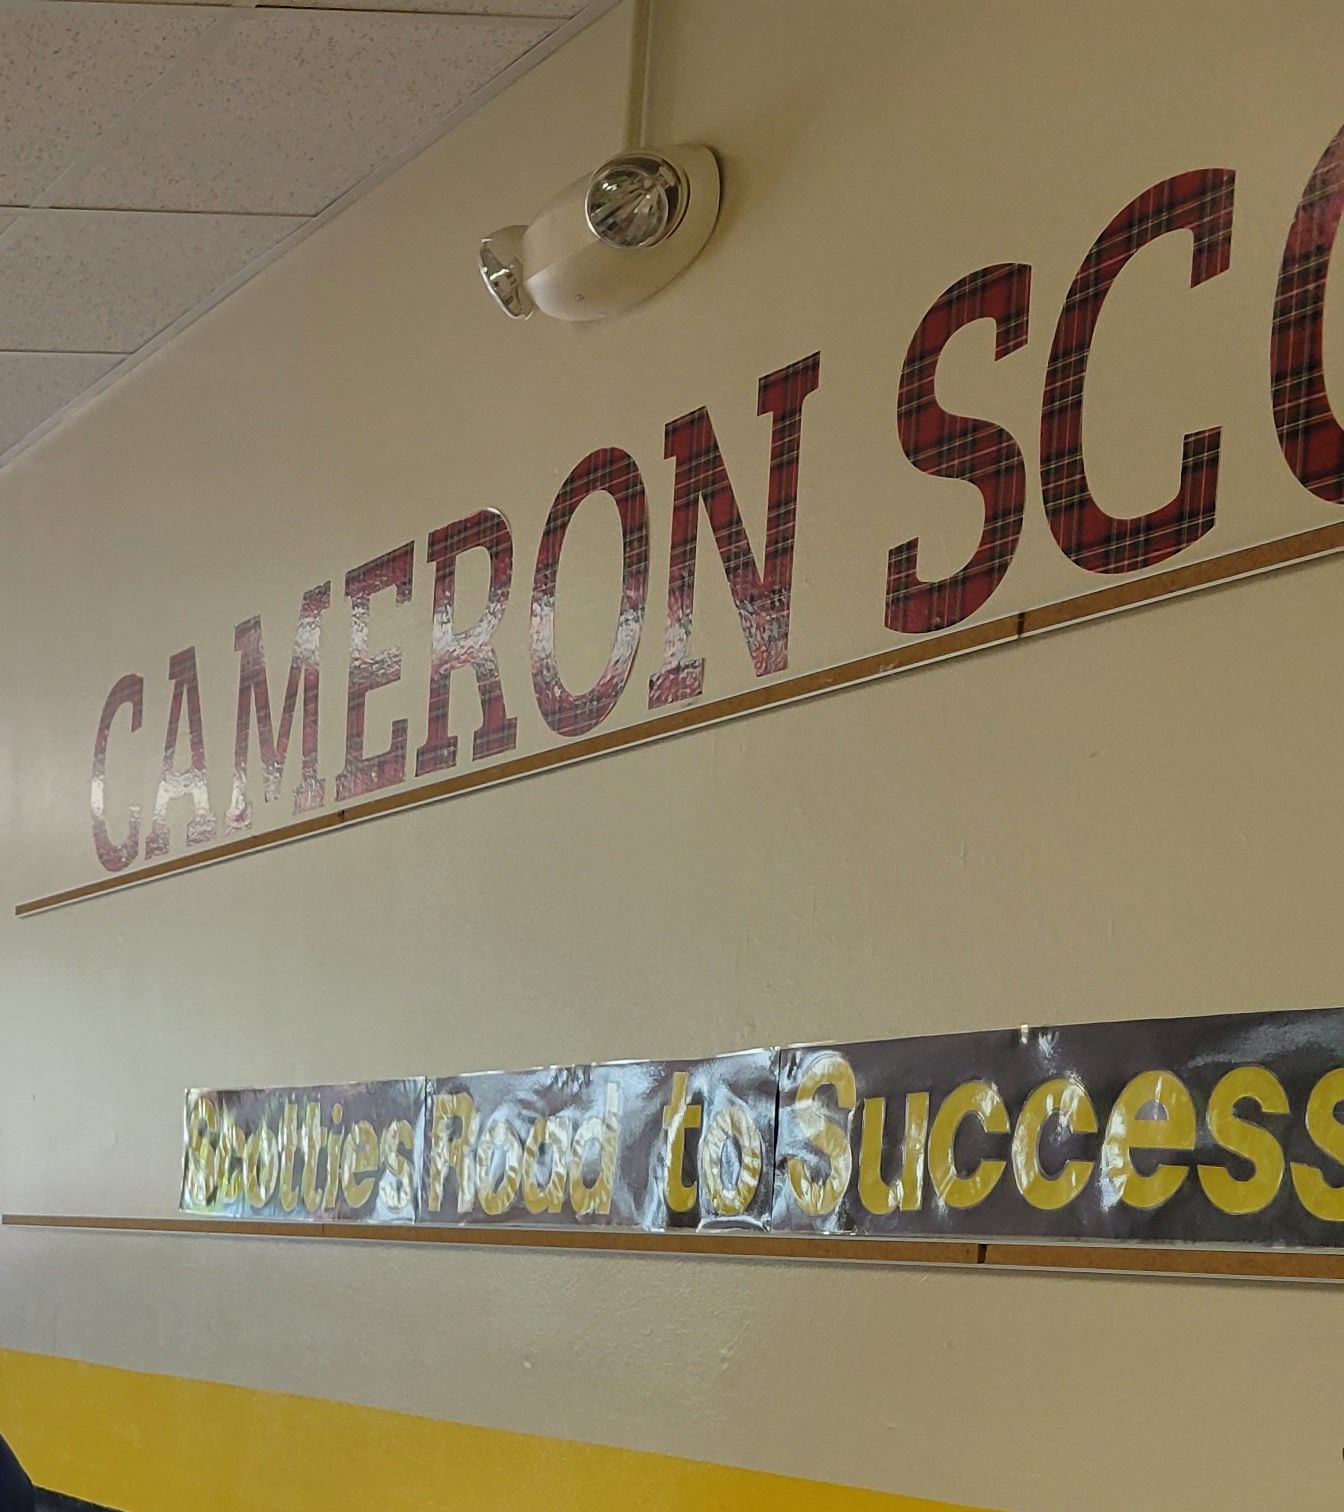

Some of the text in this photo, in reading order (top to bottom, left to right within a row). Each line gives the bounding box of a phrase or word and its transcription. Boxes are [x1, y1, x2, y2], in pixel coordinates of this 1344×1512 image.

[90, 351, 820, 872] CAMERON
[428, 1082, 621, 1215] Road
[663, 1071, 763, 1215] to
